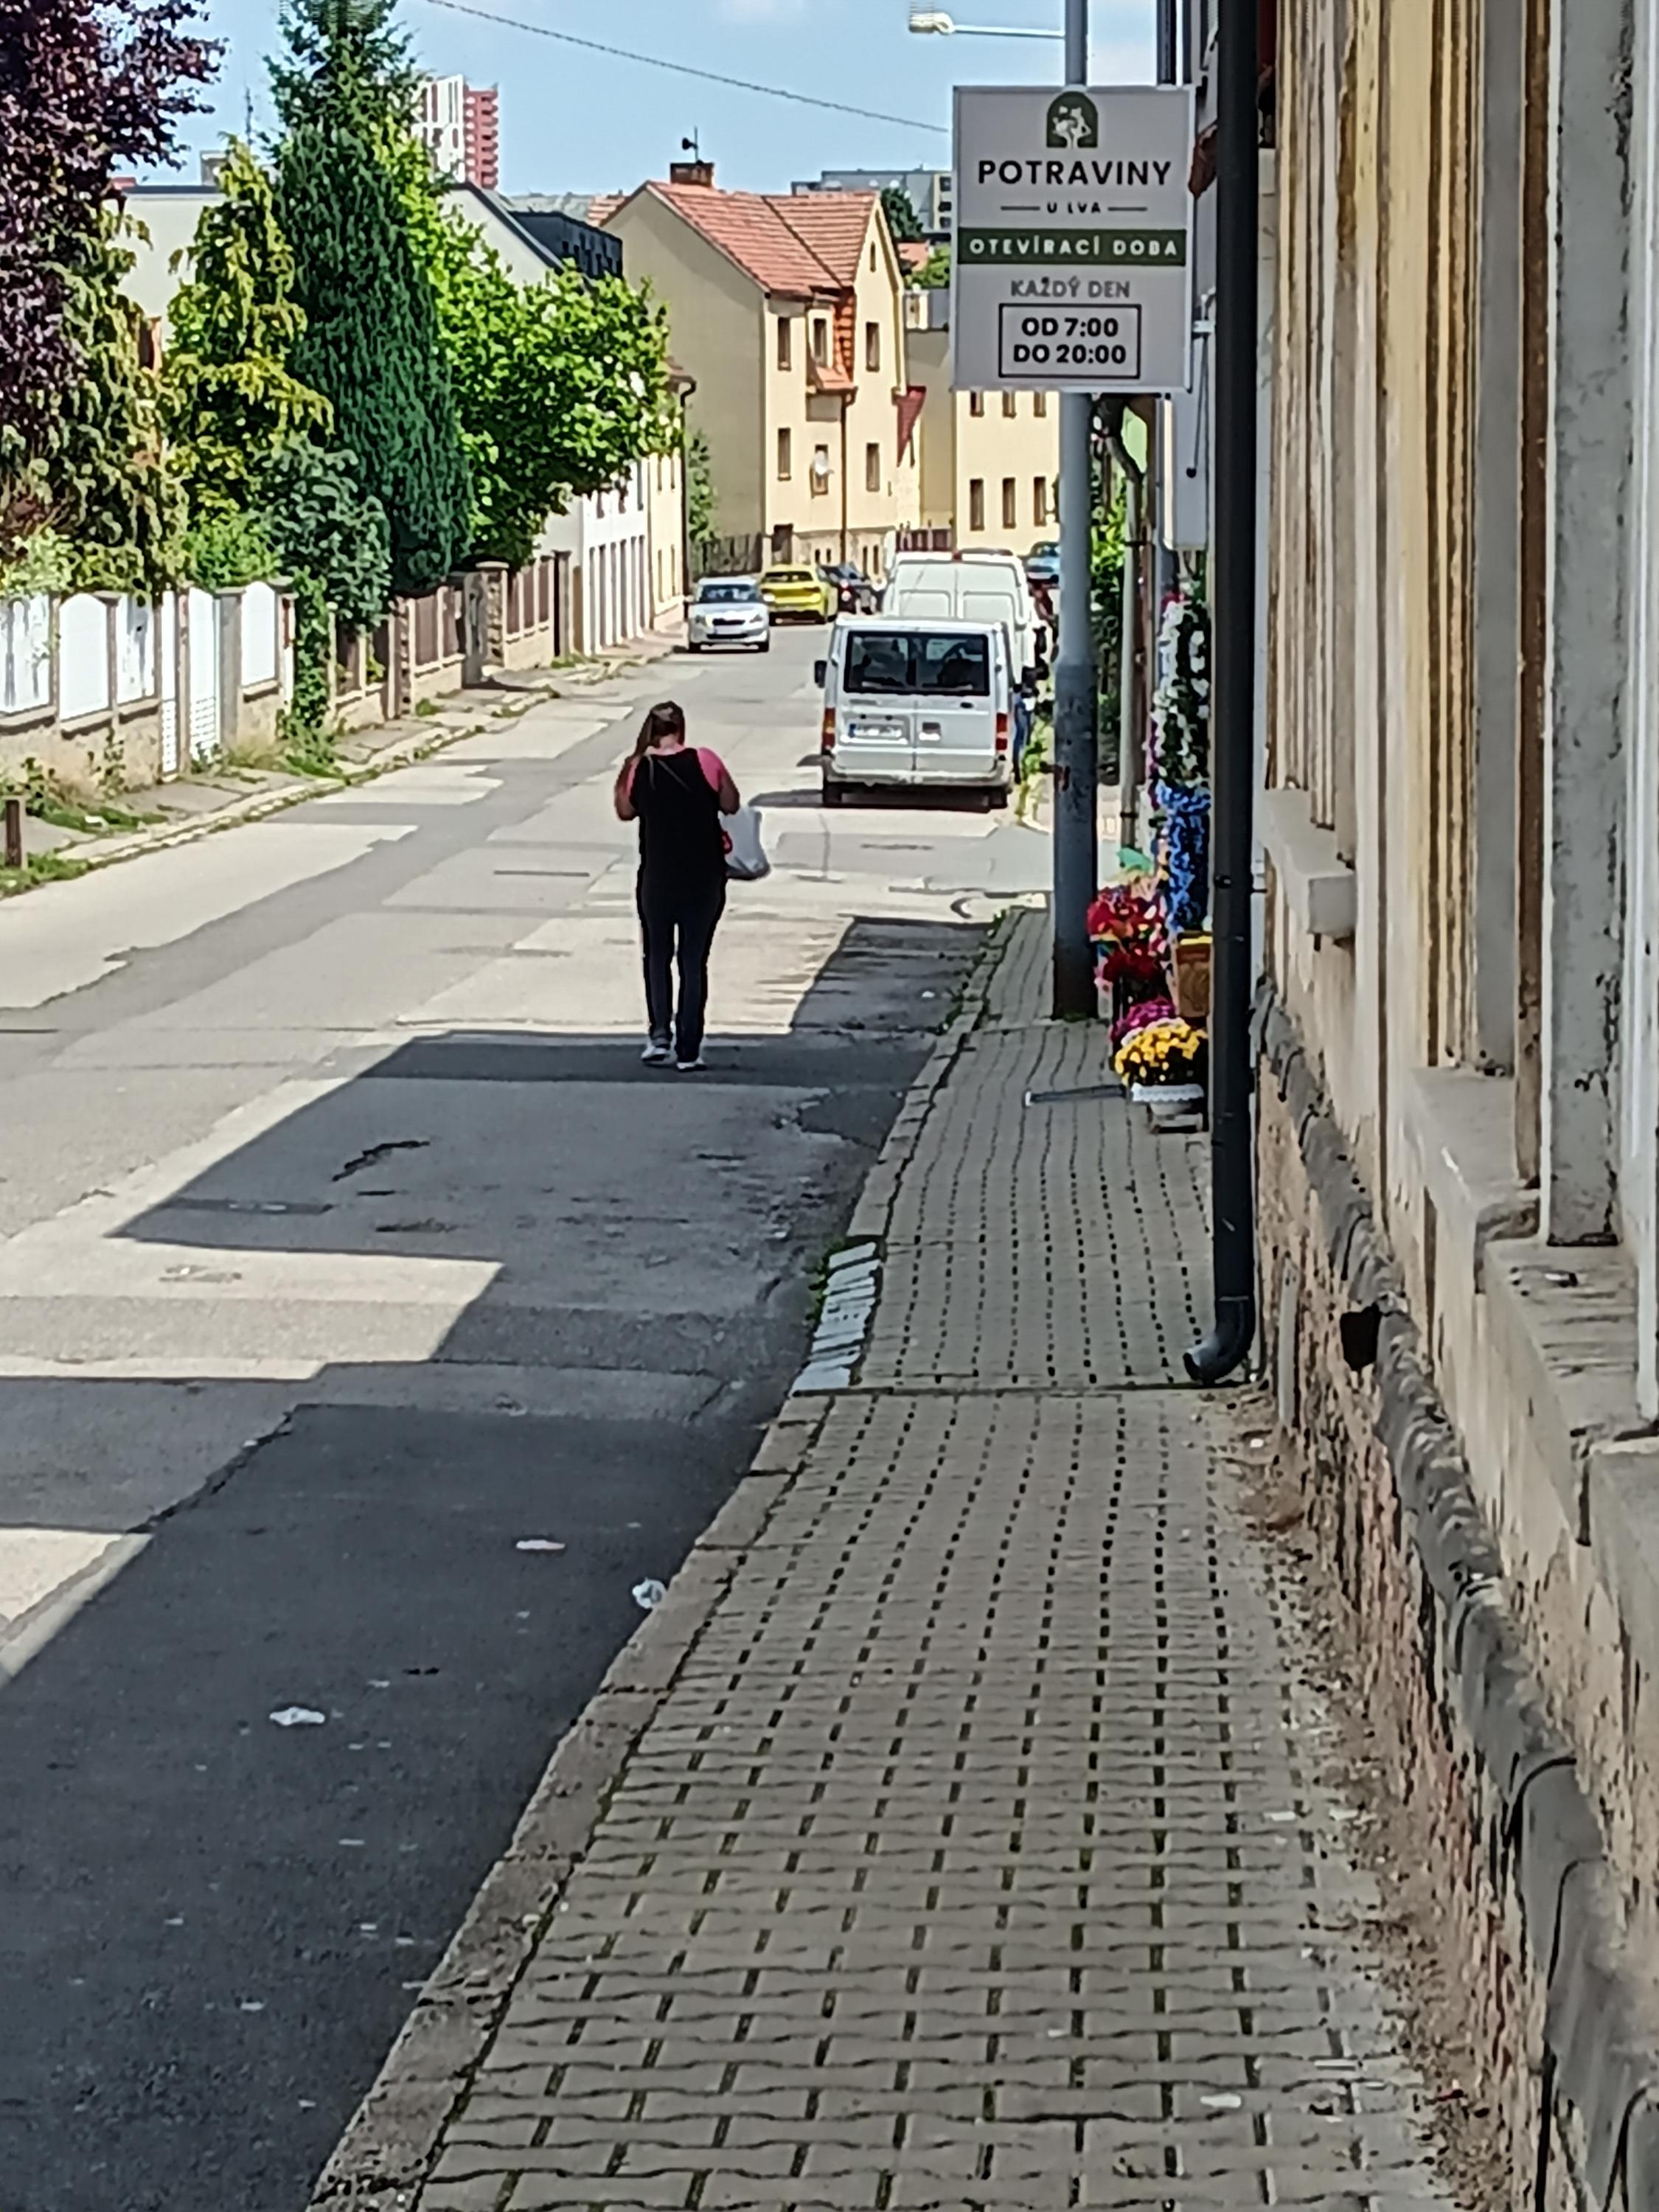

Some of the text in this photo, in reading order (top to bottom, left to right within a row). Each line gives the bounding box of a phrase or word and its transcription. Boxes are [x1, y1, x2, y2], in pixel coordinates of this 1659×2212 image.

[978, 160, 1171, 185] POTRAVINY
[1047, 202, 1058, 214] U
[969, 235, 1178, 256] OTEVÍRACÍ DOBA
[1010, 276, 1130, 299] KAŽDÝ DEN
[1021, 317, 1119, 337] OD 7:00
[1013, 344, 1127, 364] DO 20:00
